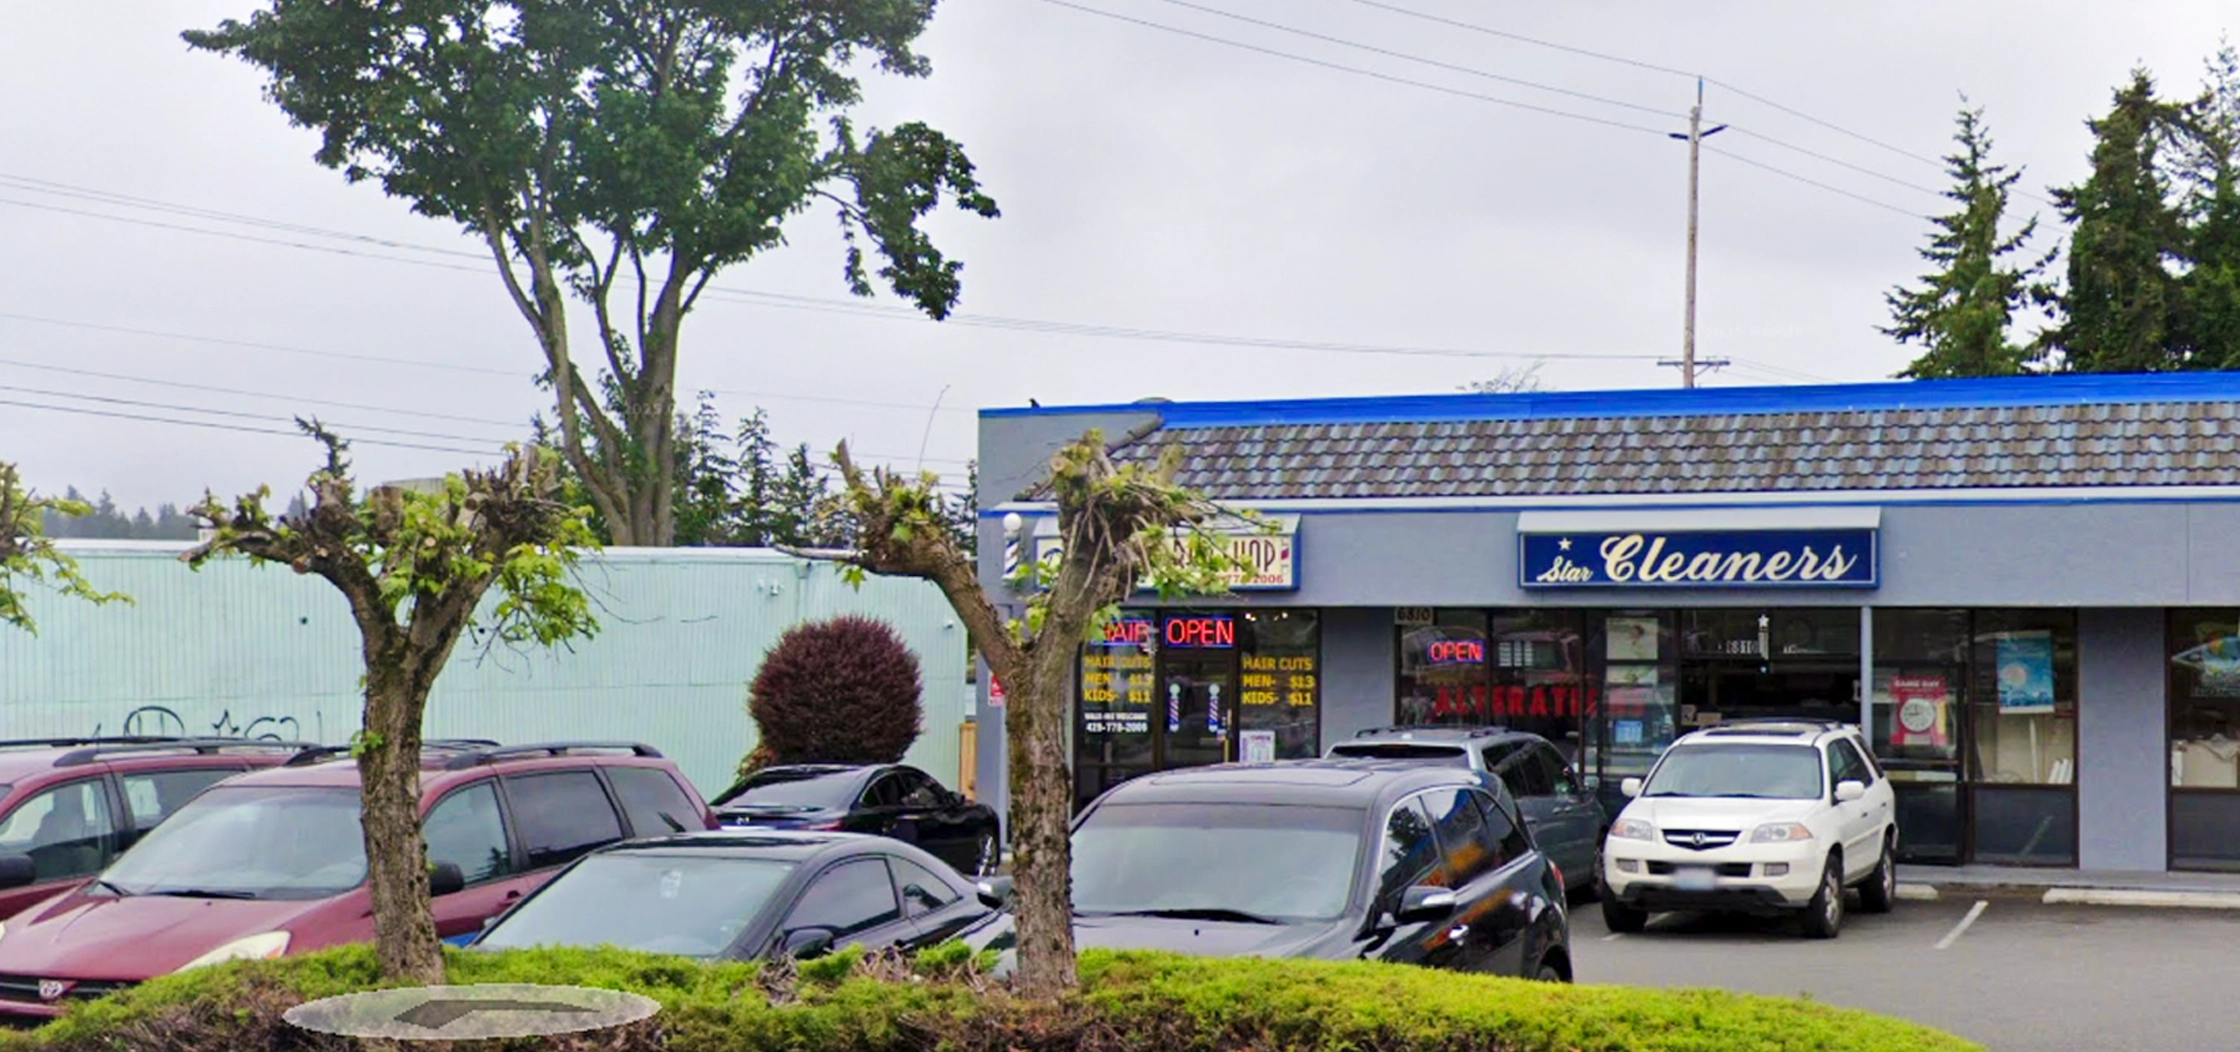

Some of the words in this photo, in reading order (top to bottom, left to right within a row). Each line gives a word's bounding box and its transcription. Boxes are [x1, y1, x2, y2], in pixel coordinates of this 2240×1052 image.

[1537, 556, 1593, 582] Star
[1600, 533, 1857, 581] Cleaners
[1167, 619, 1234, 645] OPEN
[1430, 642, 1483, 662] OPEN
[1084, 656, 1115, 669] HAIR
[1243, 657, 1276, 670] HAIR
[1279, 657, 1313, 671] CUTS
[1290, 676, 1315, 689] $13
[1242, 692, 1279, 705] KIDS-
[1289, 692, 1313, 706] $11
[1434, 683, 1645, 718] ALTERATI
